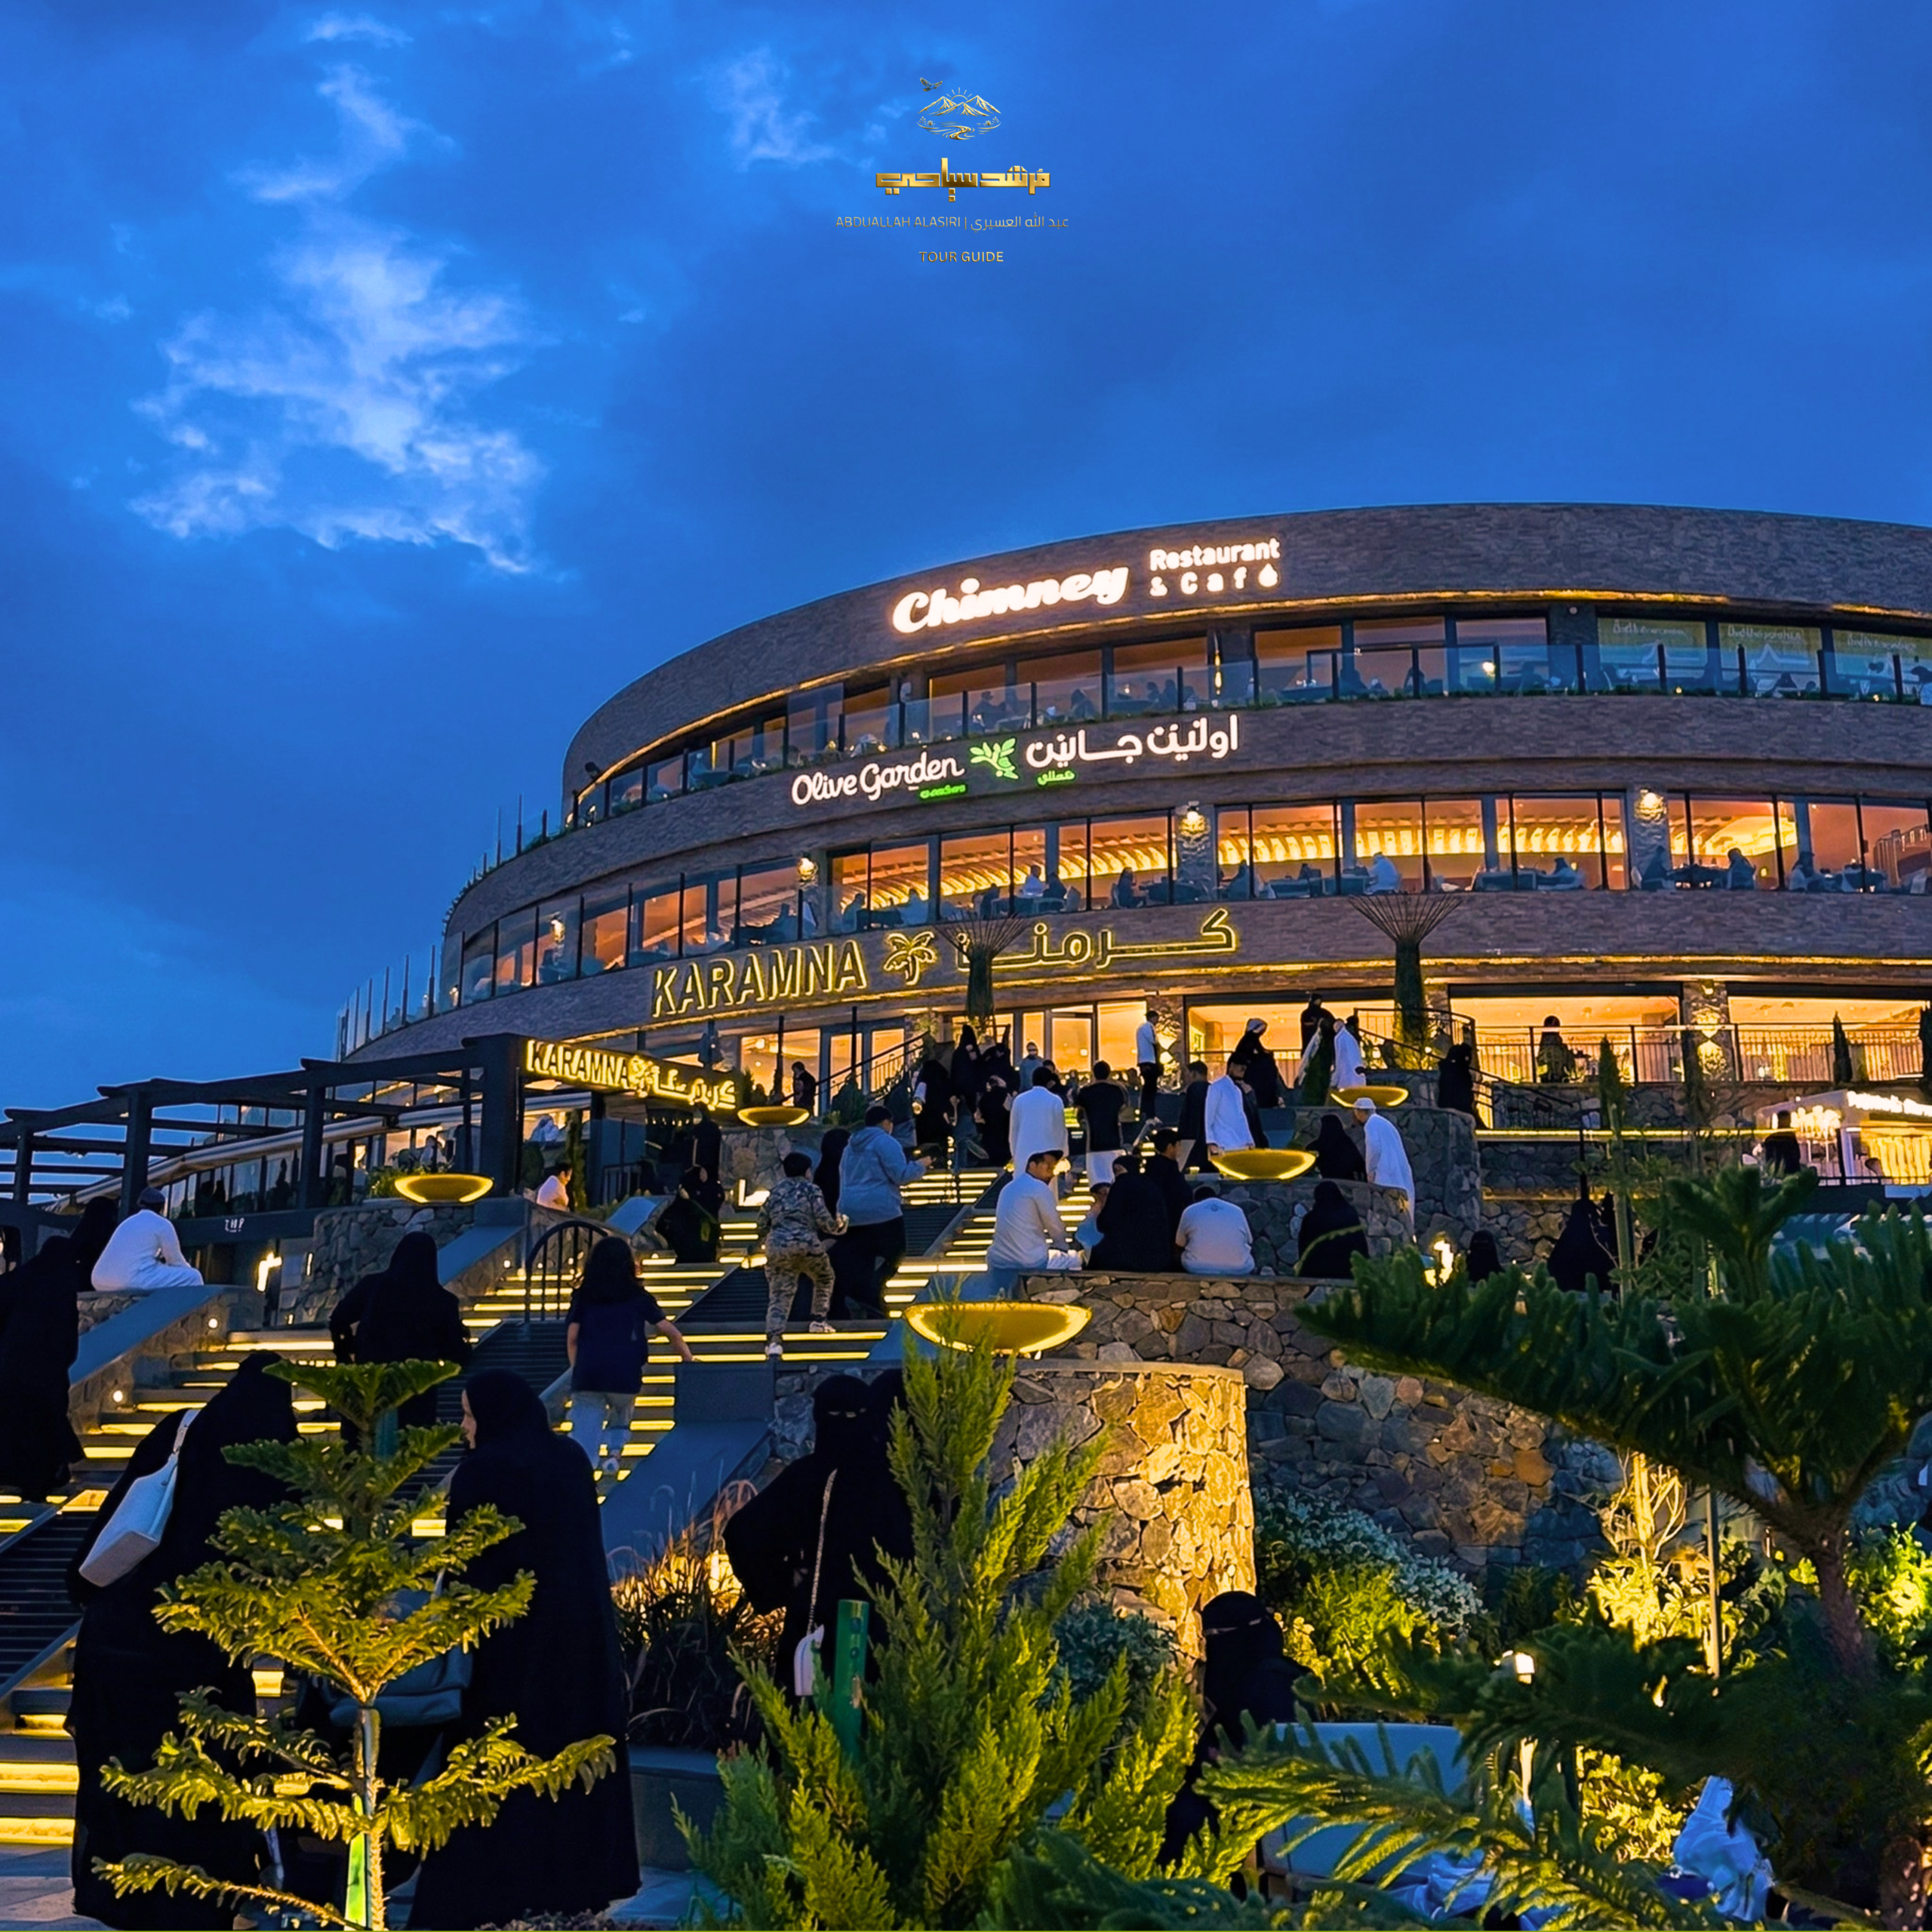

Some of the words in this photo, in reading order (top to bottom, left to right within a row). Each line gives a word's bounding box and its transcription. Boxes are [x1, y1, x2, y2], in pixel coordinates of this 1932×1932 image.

[1149, 537, 1281, 571] Restaurant
[892, 566, 1129, 634] Chimney
[1149, 576, 1168, 597] &
[792, 771, 859, 805] Olive
[860, 751, 965, 801] Garden
[652, 939, 867, 1018] KARAMNA
[527, 1039, 631, 1089] KARAMNA
